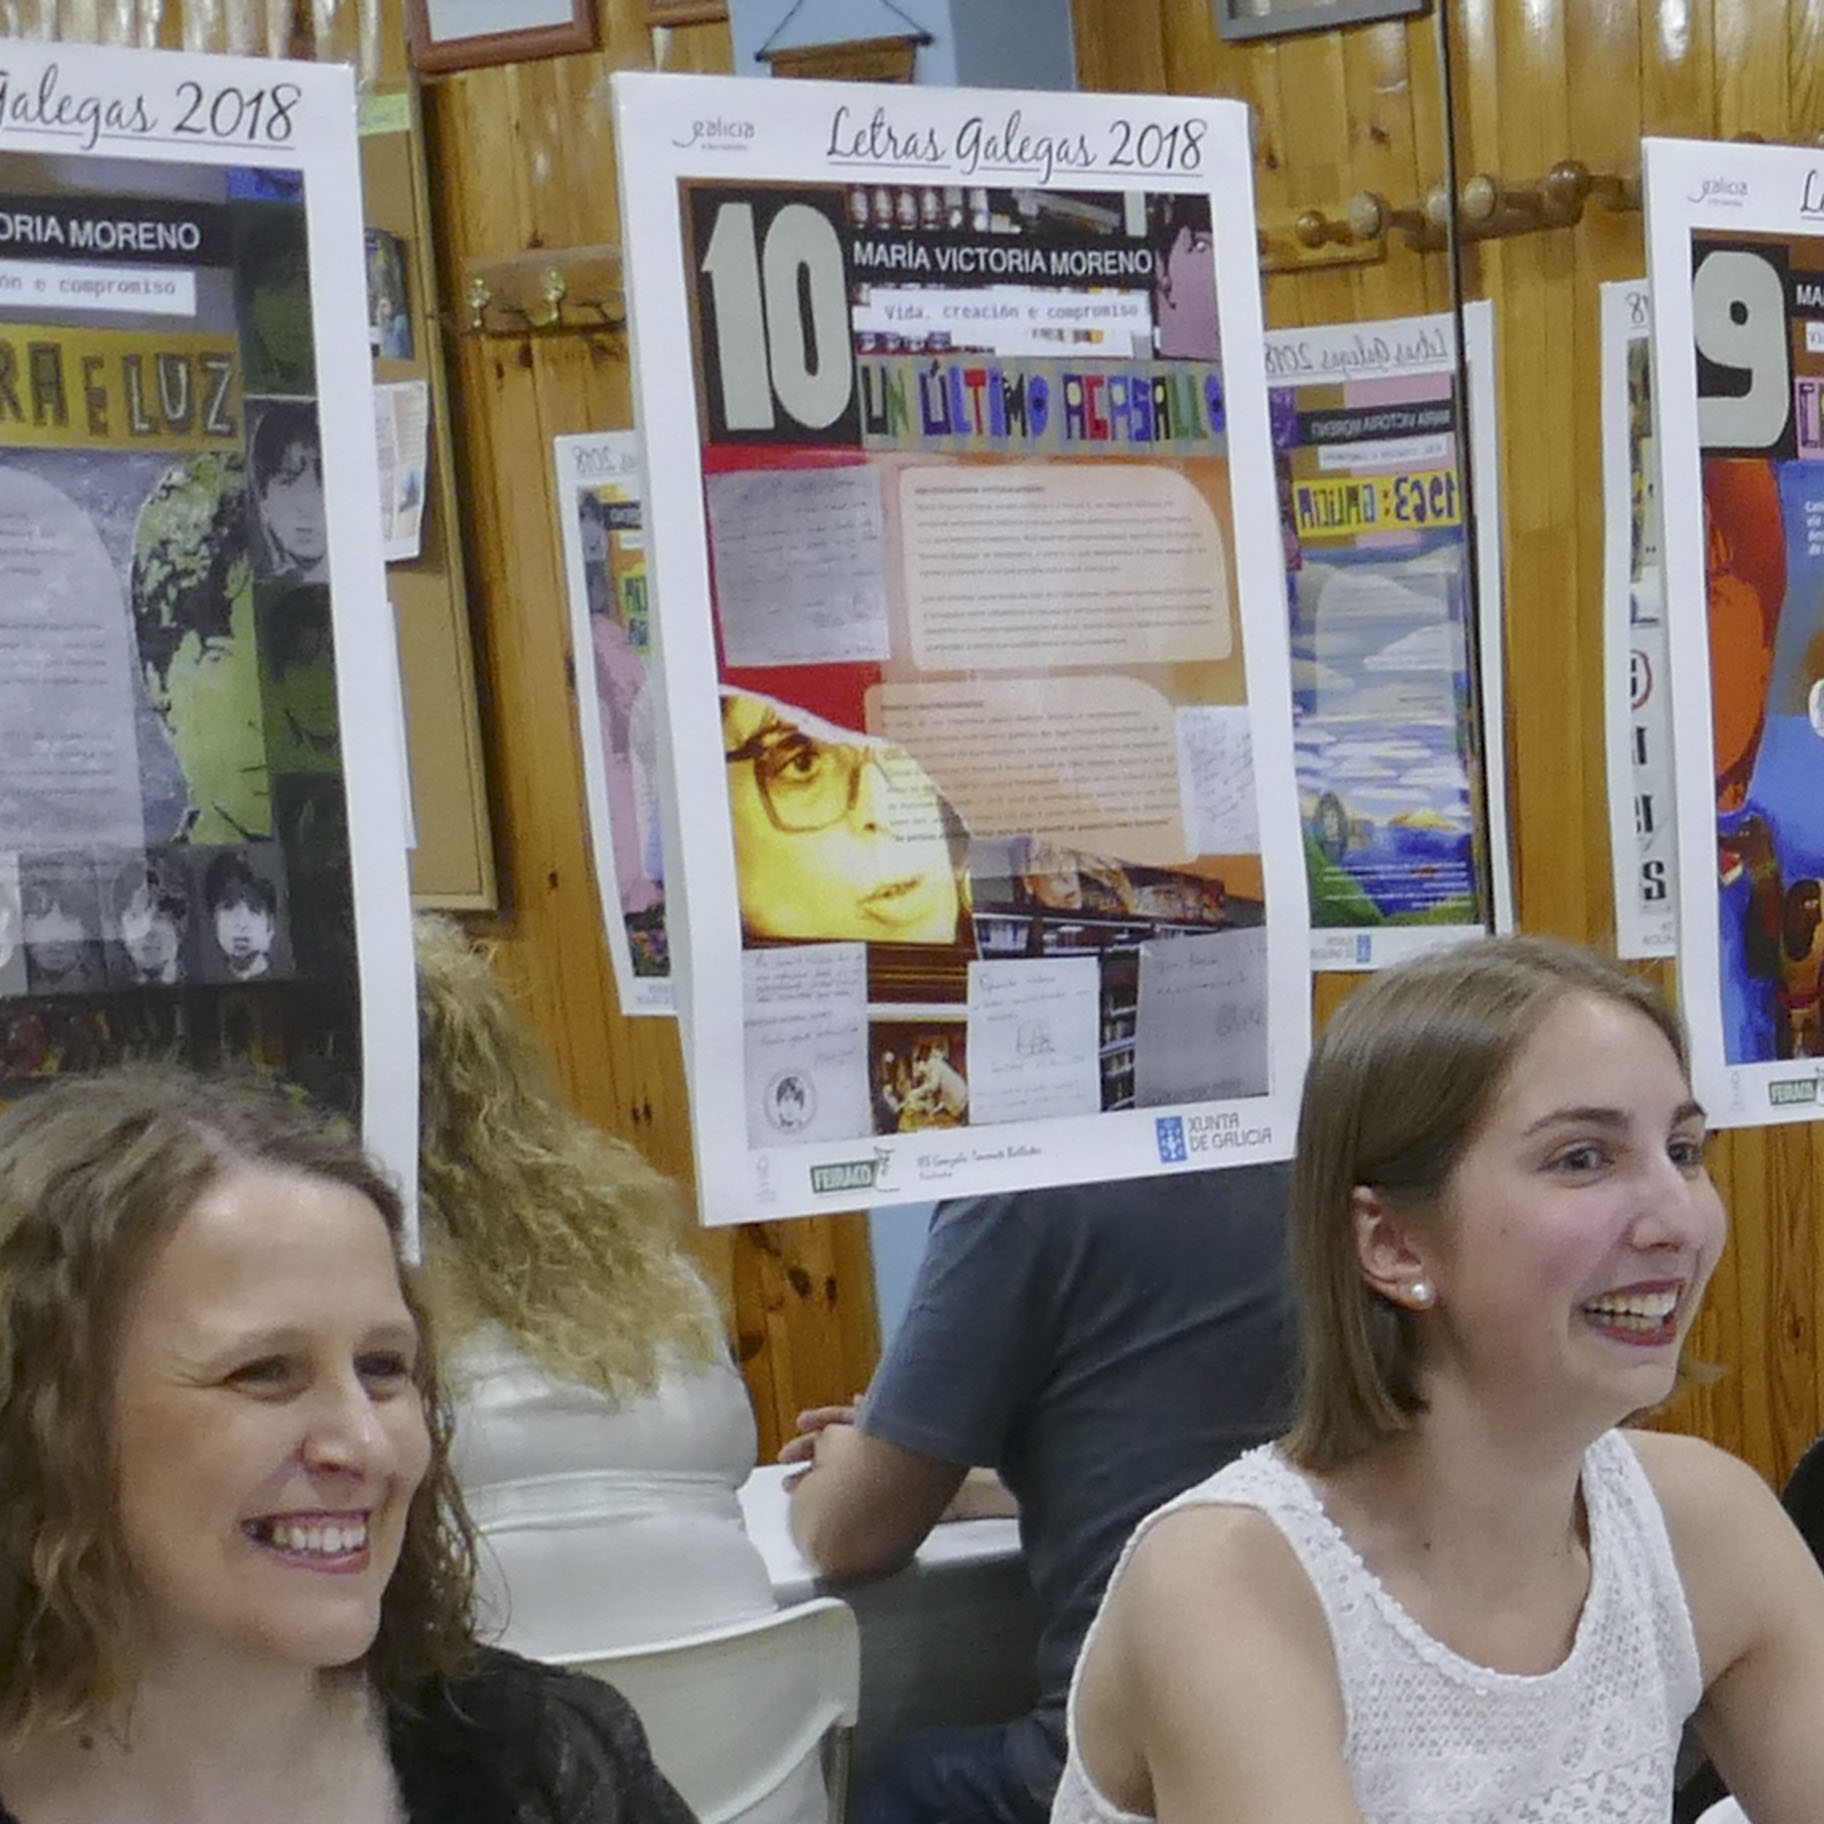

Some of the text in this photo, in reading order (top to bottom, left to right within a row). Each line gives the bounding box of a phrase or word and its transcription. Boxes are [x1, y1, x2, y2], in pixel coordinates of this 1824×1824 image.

[173, 80, 302, 141] 2018
[672, 115, 754, 148] galicia
[826, 106, 1208, 184] Letras Galegas 2018
[69, 219, 201, 252] MORENO
[853, 239, 1153, 277] MARÍA VICTORIA MORENO
[34, 276, 48, 290] e
[57, 275, 177, 300] compromiso
[701, 201, 854, 432] 10
[942, 302, 1019, 321] creación
[1028, 307, 1039, 319] e
[1046, 304, 1138, 323] compromiso
[1692, 250, 1791, 449] 9
[123, 350, 239, 440] LUZ
[861, 365, 907, 441] UN
[919, 360, 1049, 442] ÚLTIMO
[1187, 1112, 1241, 1133] XUNTA
[1189, 1126, 1273, 1153] DE GALICIA
